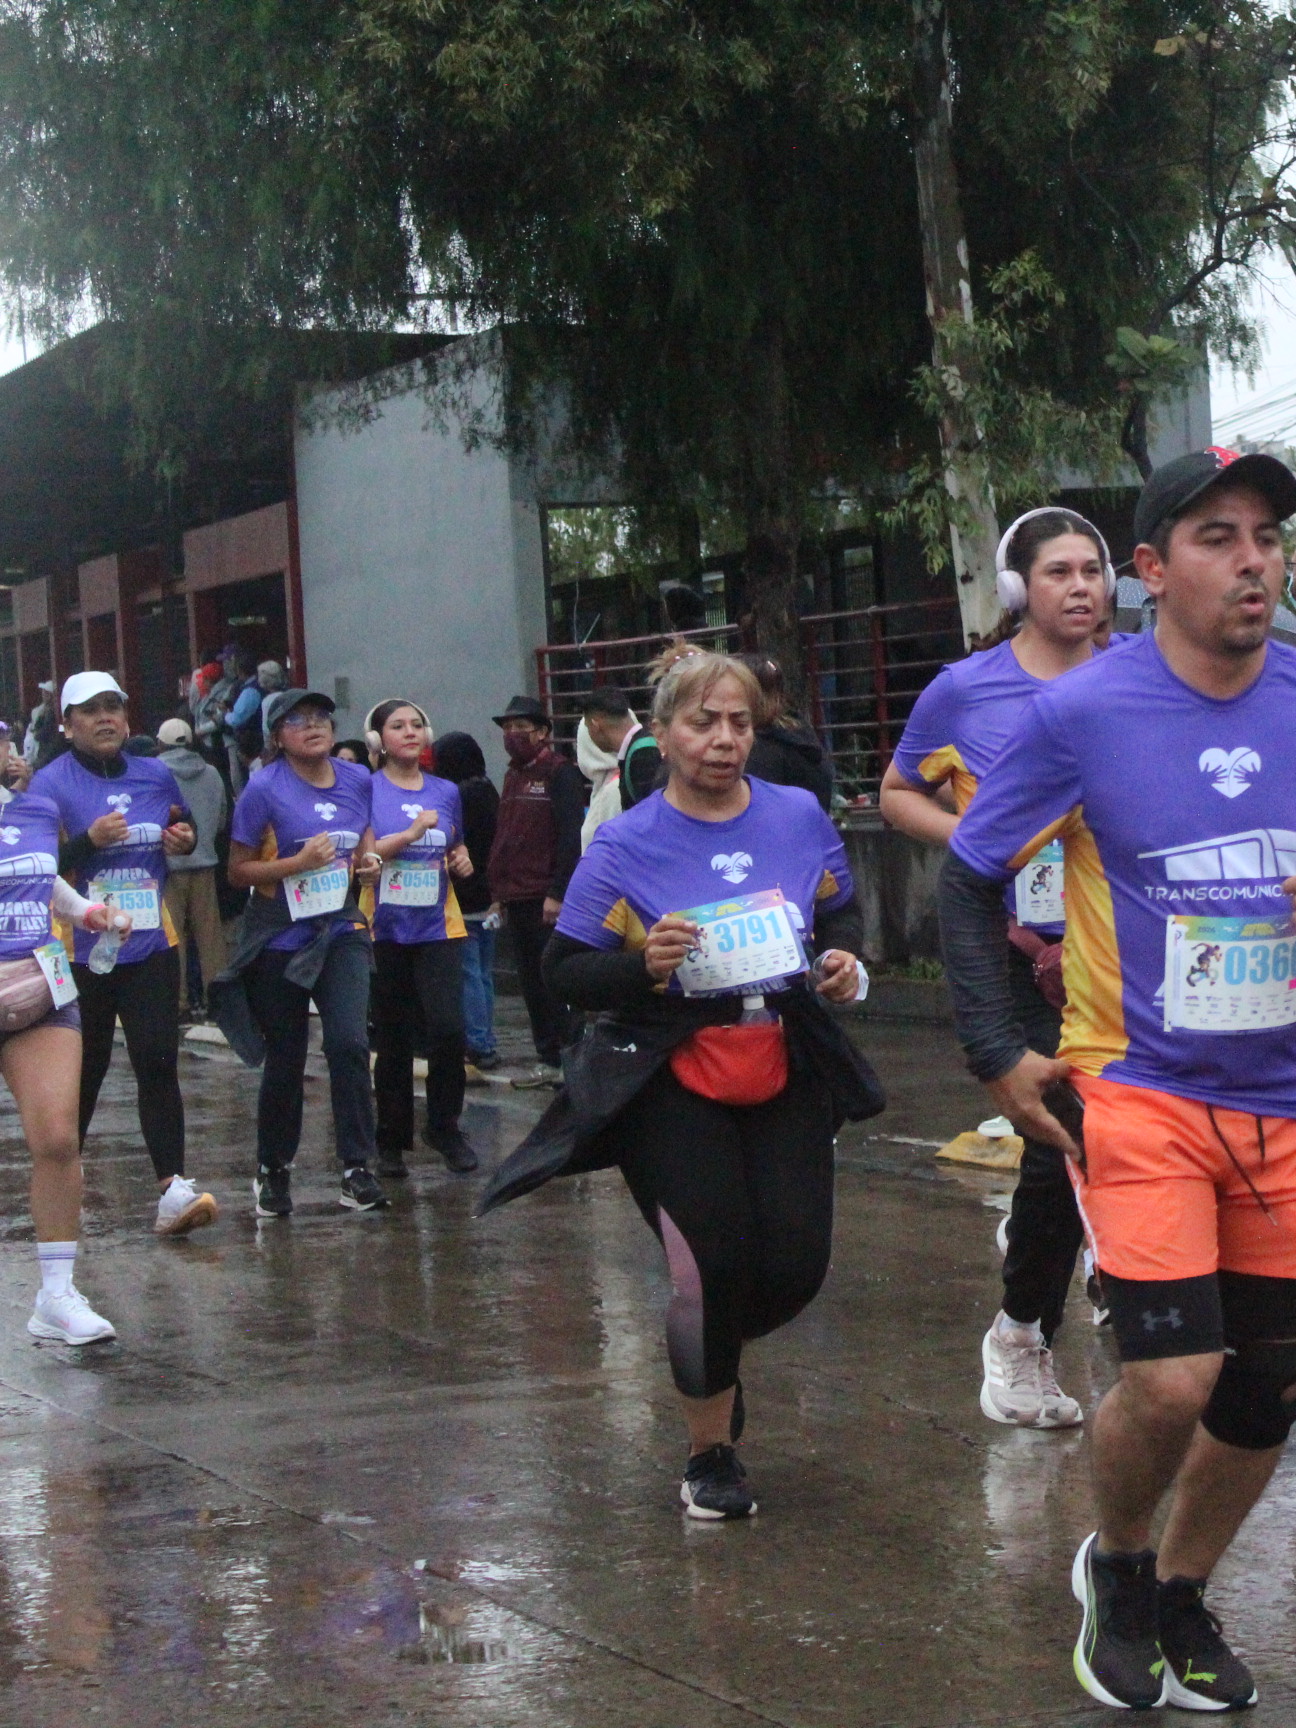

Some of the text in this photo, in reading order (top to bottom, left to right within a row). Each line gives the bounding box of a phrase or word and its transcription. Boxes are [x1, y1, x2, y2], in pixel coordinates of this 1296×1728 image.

[403, 871, 437, 888] 0545
[117, 891, 155, 911] 1538
[1144, 882, 1294, 901] TRANSCOMUNIC
[713, 910, 784, 954] 3791
